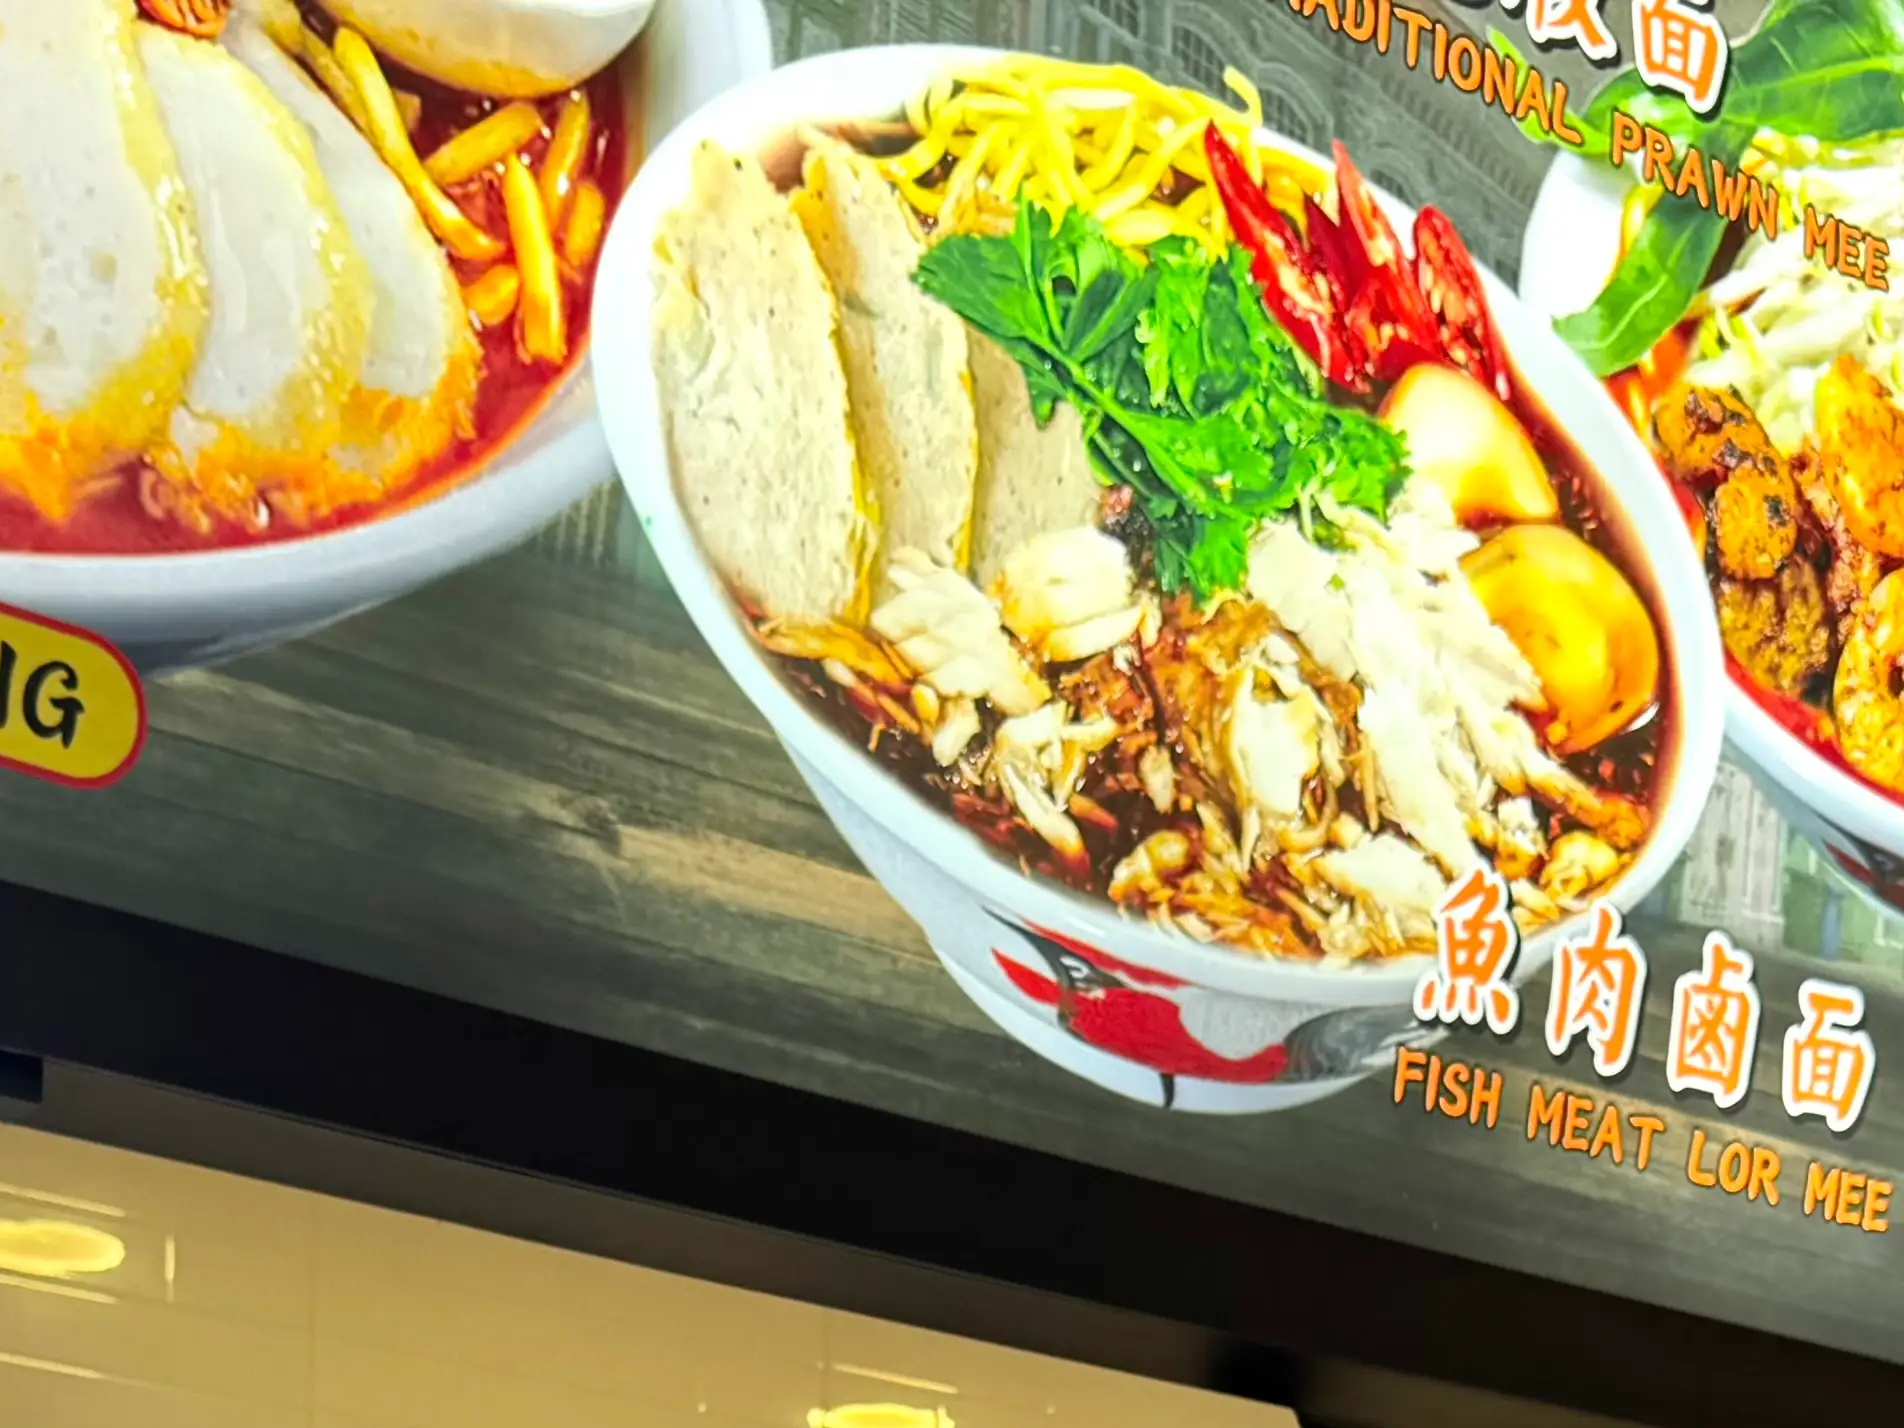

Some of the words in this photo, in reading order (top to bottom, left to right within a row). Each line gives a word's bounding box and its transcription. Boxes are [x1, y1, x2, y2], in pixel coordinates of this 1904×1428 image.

[1610, 110, 1780, 239] PRAWN
[1802, 206, 1890, 291] MEE
[1394, 1046, 1502, 1129] FISH
[1527, 1084, 1665, 1171] MEAT
[1687, 1130, 1779, 1206] LOR
[1803, 1162, 1894, 1233] MEE
